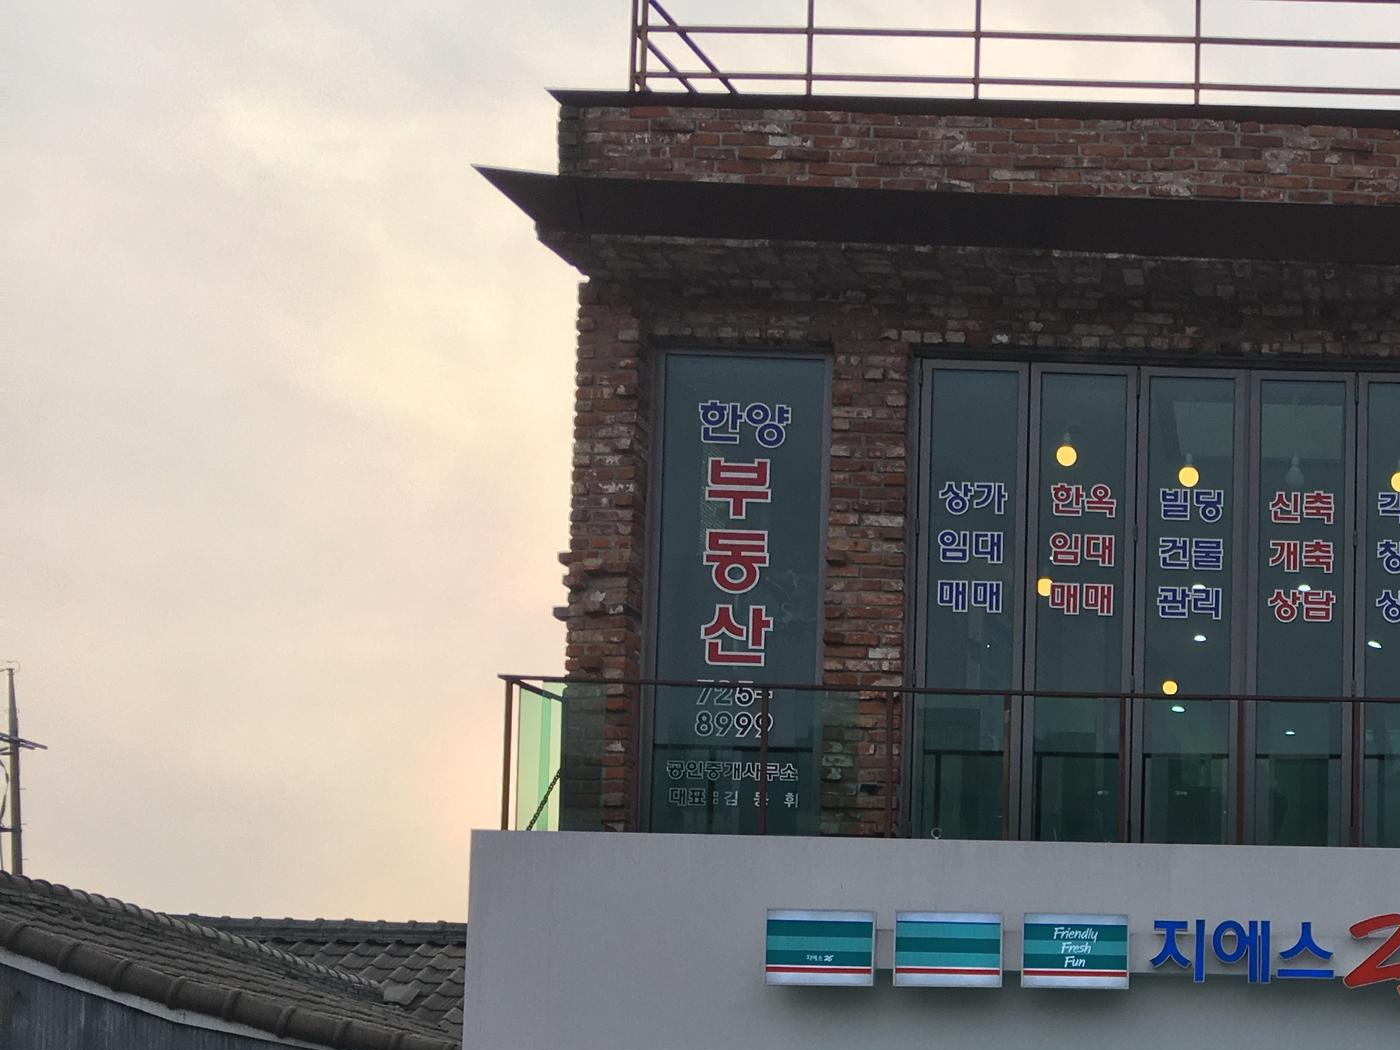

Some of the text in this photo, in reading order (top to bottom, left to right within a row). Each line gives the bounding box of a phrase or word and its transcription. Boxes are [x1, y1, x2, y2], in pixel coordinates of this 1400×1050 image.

[699, 400, 791, 448] 한양
[939, 481, 1008, 515] 상가
[1051, 483, 1116, 518] 한옥
[1160, 488, 1223, 523] 빌딩
[1269, 491, 1334, 524] 신축
[701, 457, 774, 667] 부동산
[938, 530, 1003, 563] 임대
[1050, 532, 1115, 566] 임대
[1159, 537, 1223, 571] 건물
[1269, 539, 1334, 573] 개축
[937, 580, 1002, 613] 매매
[1049, 583, 1113, 616] 매매
[1157, 586, 1222, 620] 관리
[1268, 589, 1336, 622] 상담
[694, 710, 773, 738] 8999
[1053, 926, 1098, 943] Friendly
[1061, 941, 1092, 955] Fresh
[1063, 956, 1086, 968] Fun
